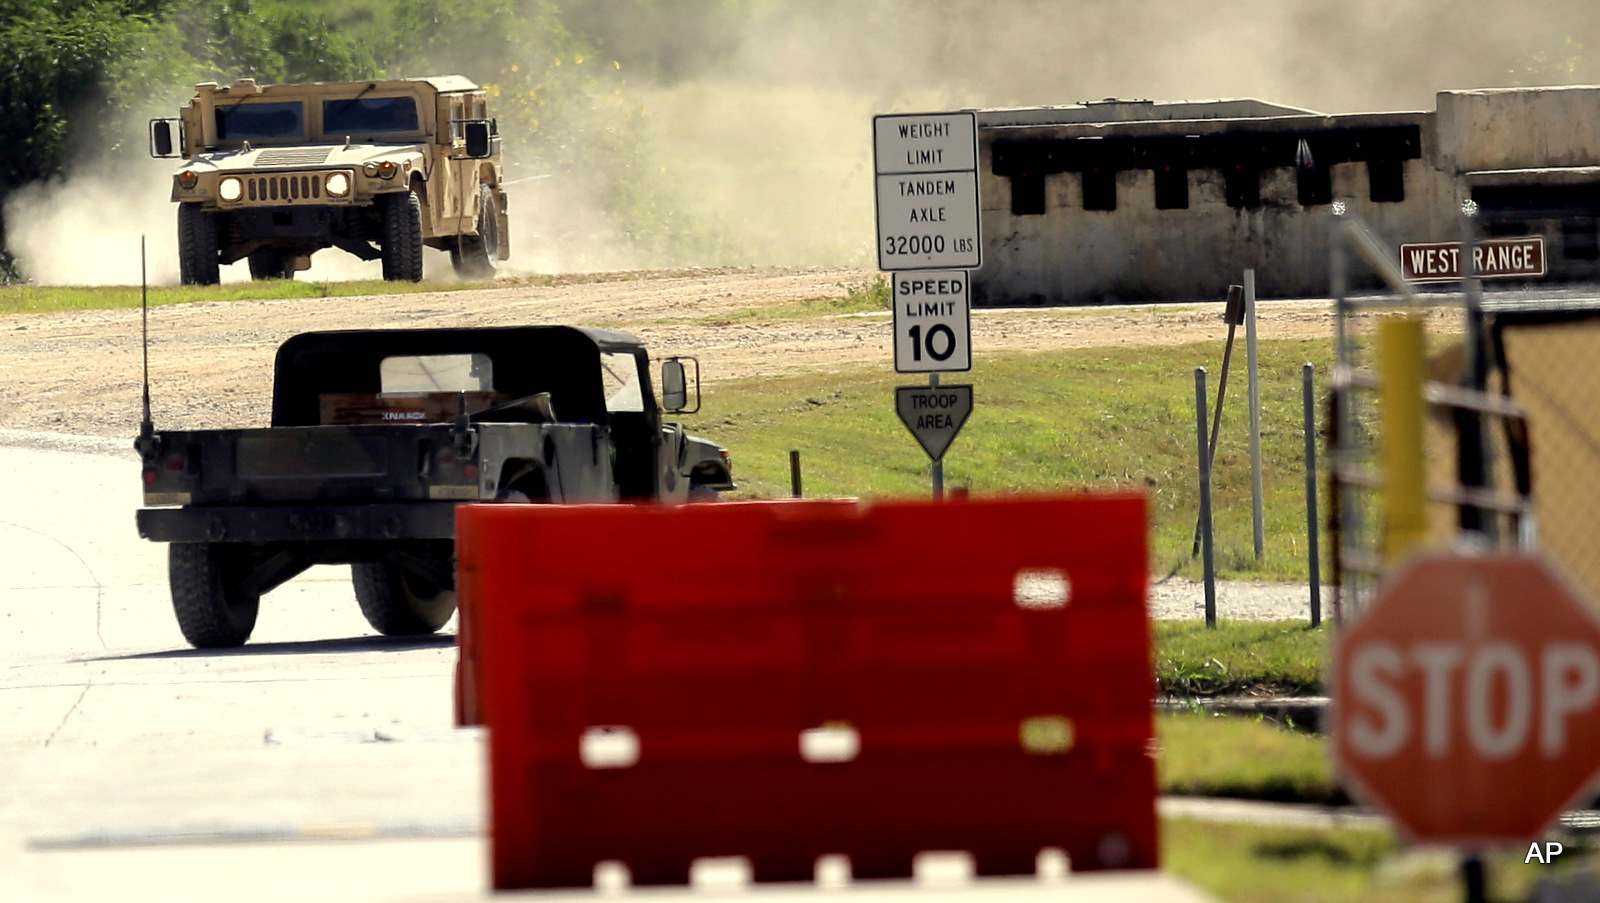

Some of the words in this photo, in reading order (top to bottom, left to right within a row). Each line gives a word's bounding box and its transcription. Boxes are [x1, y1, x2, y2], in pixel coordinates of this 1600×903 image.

[898, 123, 950, 139] WEIGHT
[907, 149, 943, 165] LIMIT
[899, 181, 955, 197] TANDEM
[910, 207, 946, 223] AXLE
[886, 235, 945, 255] 32000
[953, 238, 973, 253] LBS
[1410, 248, 1460, 274] WEST
[1472, 245, 1534, 271] RANGE
[900, 280, 963, 295] SPEED
[907, 302, 955, 317] LIMIT
[908, 323, 957, 361] 10
[911, 394, 958, 409] TROOP
[916, 414, 953, 430] AREA
[1347, 642, 1600, 760] STOP
